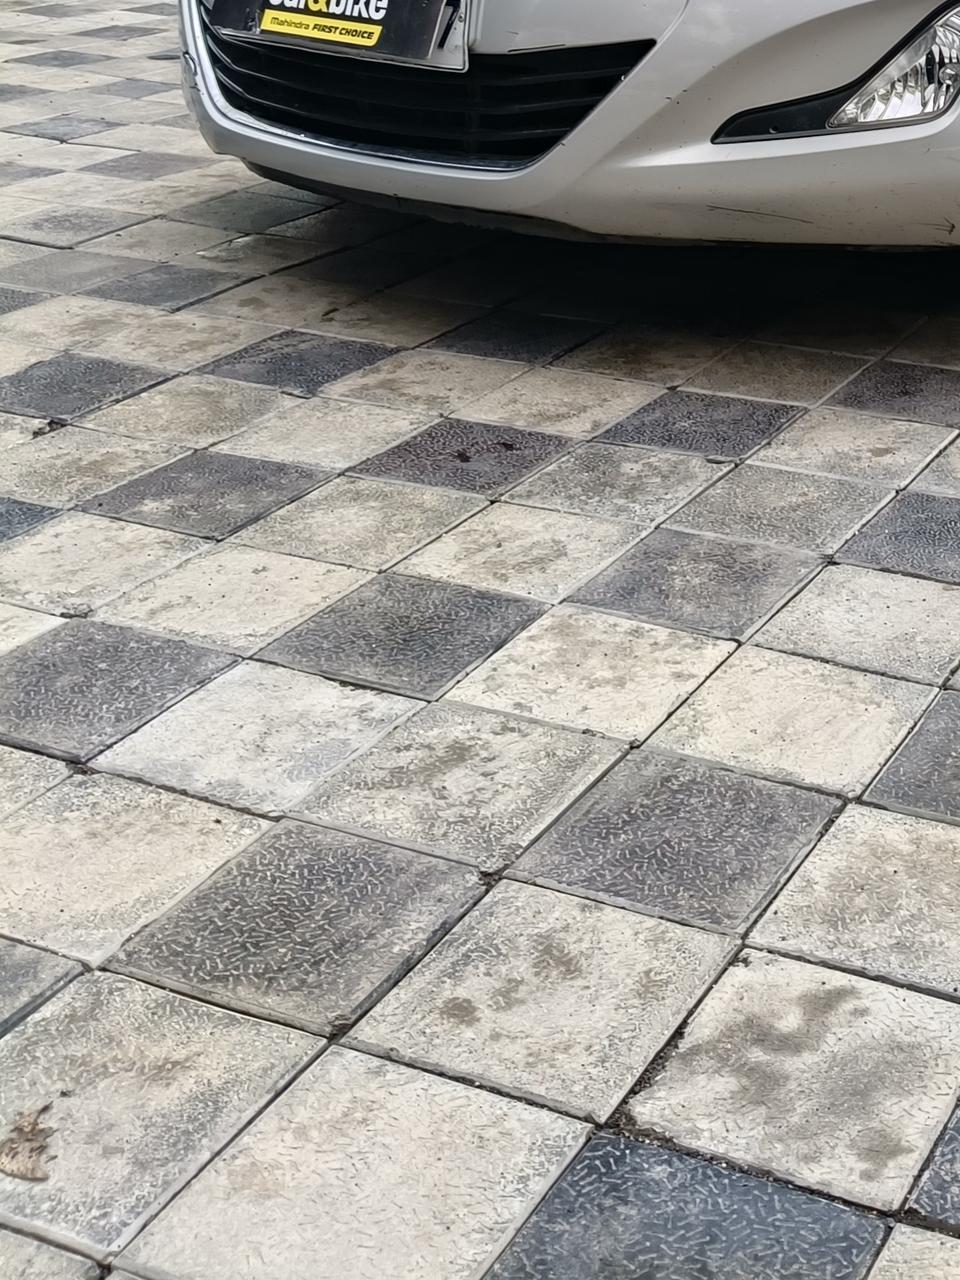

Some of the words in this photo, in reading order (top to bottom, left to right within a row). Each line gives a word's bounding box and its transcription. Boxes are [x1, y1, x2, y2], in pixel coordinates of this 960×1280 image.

[270, 17, 310, 30] Mahindra
[311, 23, 340, 33] FIRST
[340, 28, 374, 39] CHOICE
